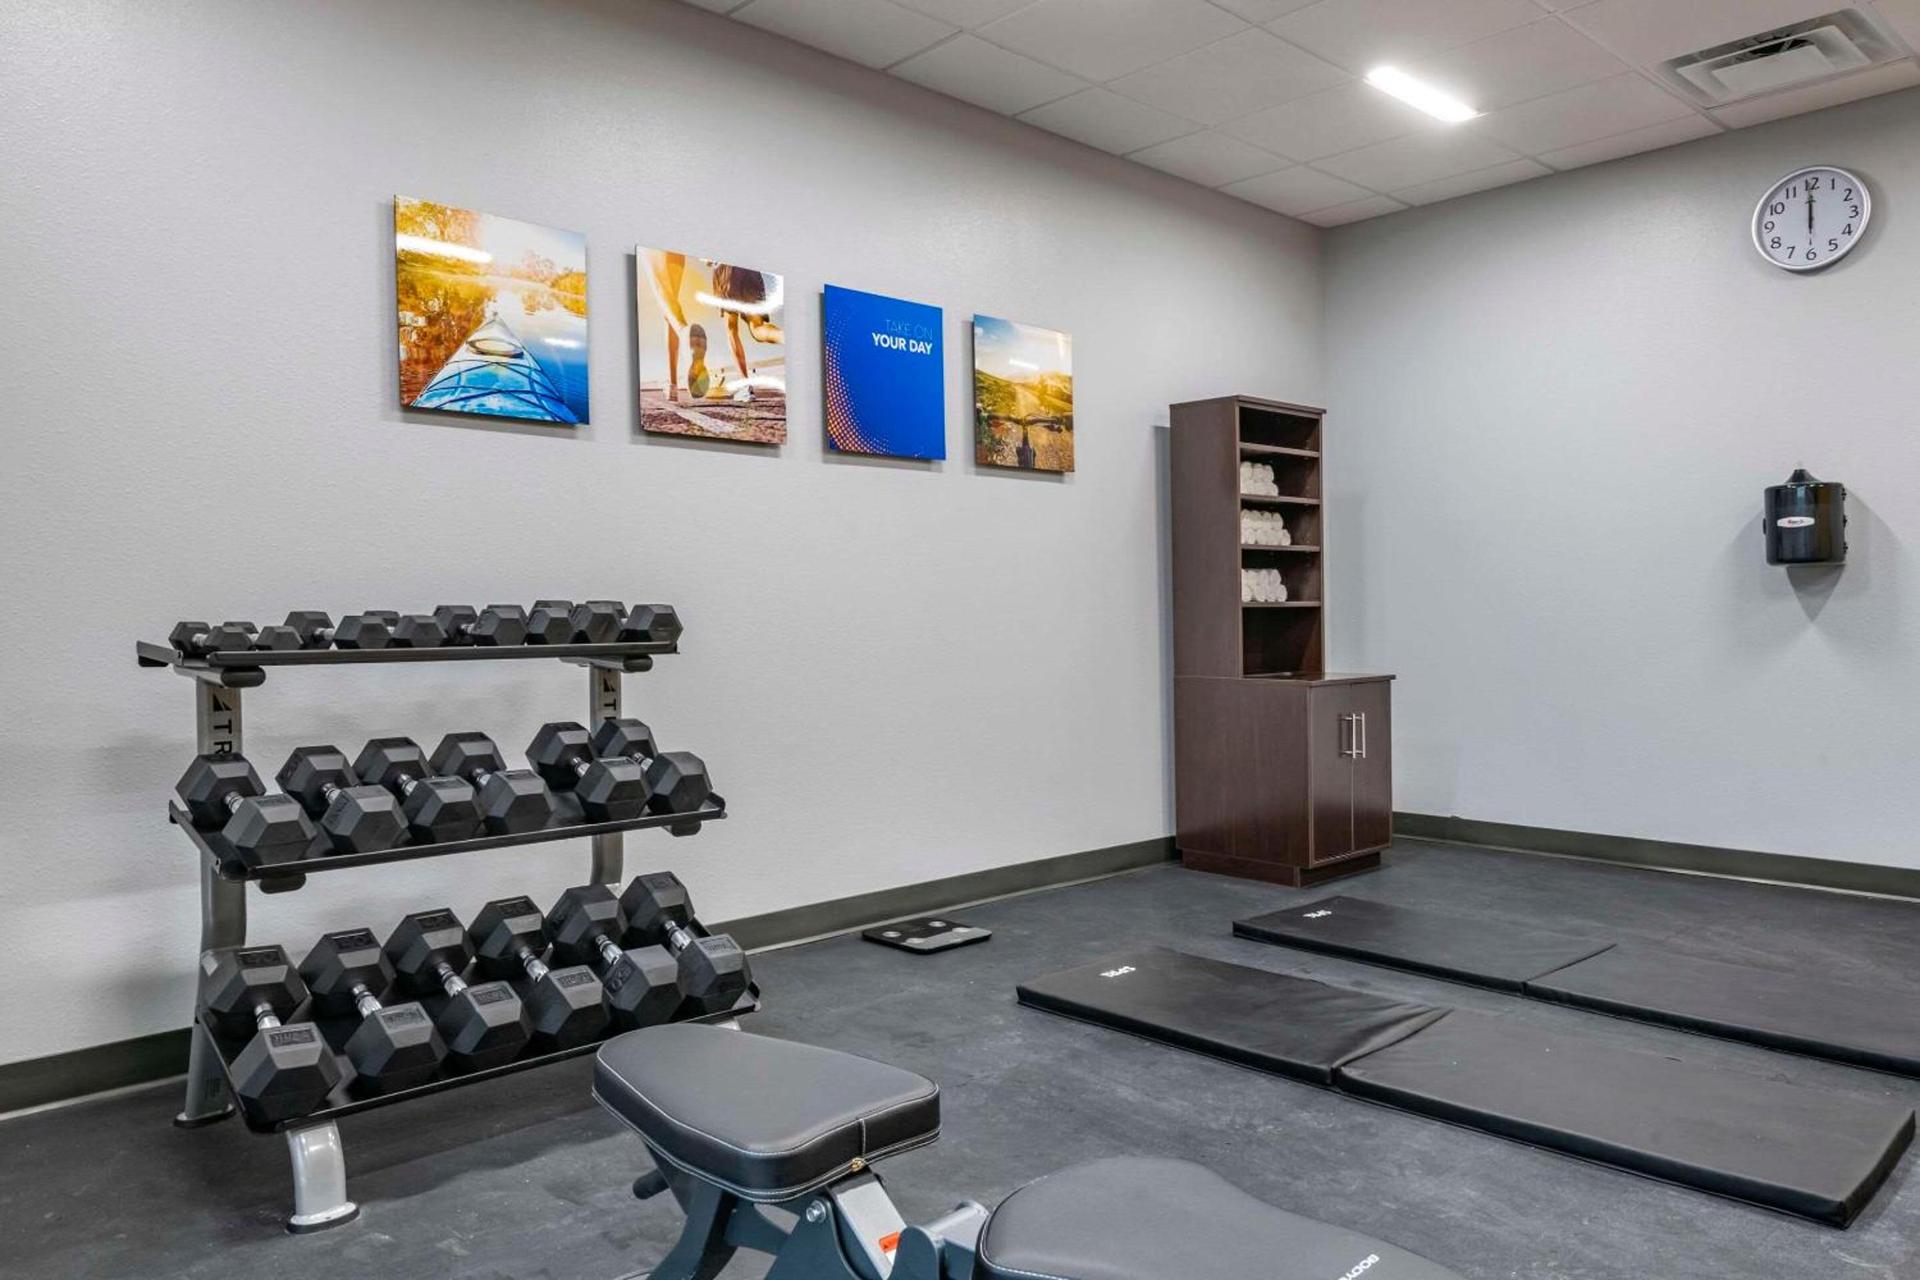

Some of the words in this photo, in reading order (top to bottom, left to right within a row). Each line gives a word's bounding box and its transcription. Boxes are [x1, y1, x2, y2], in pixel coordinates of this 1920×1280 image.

[1805, 177, 1820, 191] 12
[1786, 186, 1797, 199] 11
[1843, 188, 1853, 201] 2
[1770, 201, 1785, 215] 10
[1848, 205, 1859, 218] 3
[1764, 220, 1775, 233] 9
[1842, 223, 1853, 236] 4
[1770, 236, 1781, 249] 8
[1828, 238, 1839, 252] 5
[1786, 246, 1796, 259] 7
[1806, 248, 1817, 260] 6
[886, 319, 911, 334] TAKE
[914, 325, 933, 340] ON
[872, 332, 907, 351] YOUR
[909, 340, 933, 355] DAY
